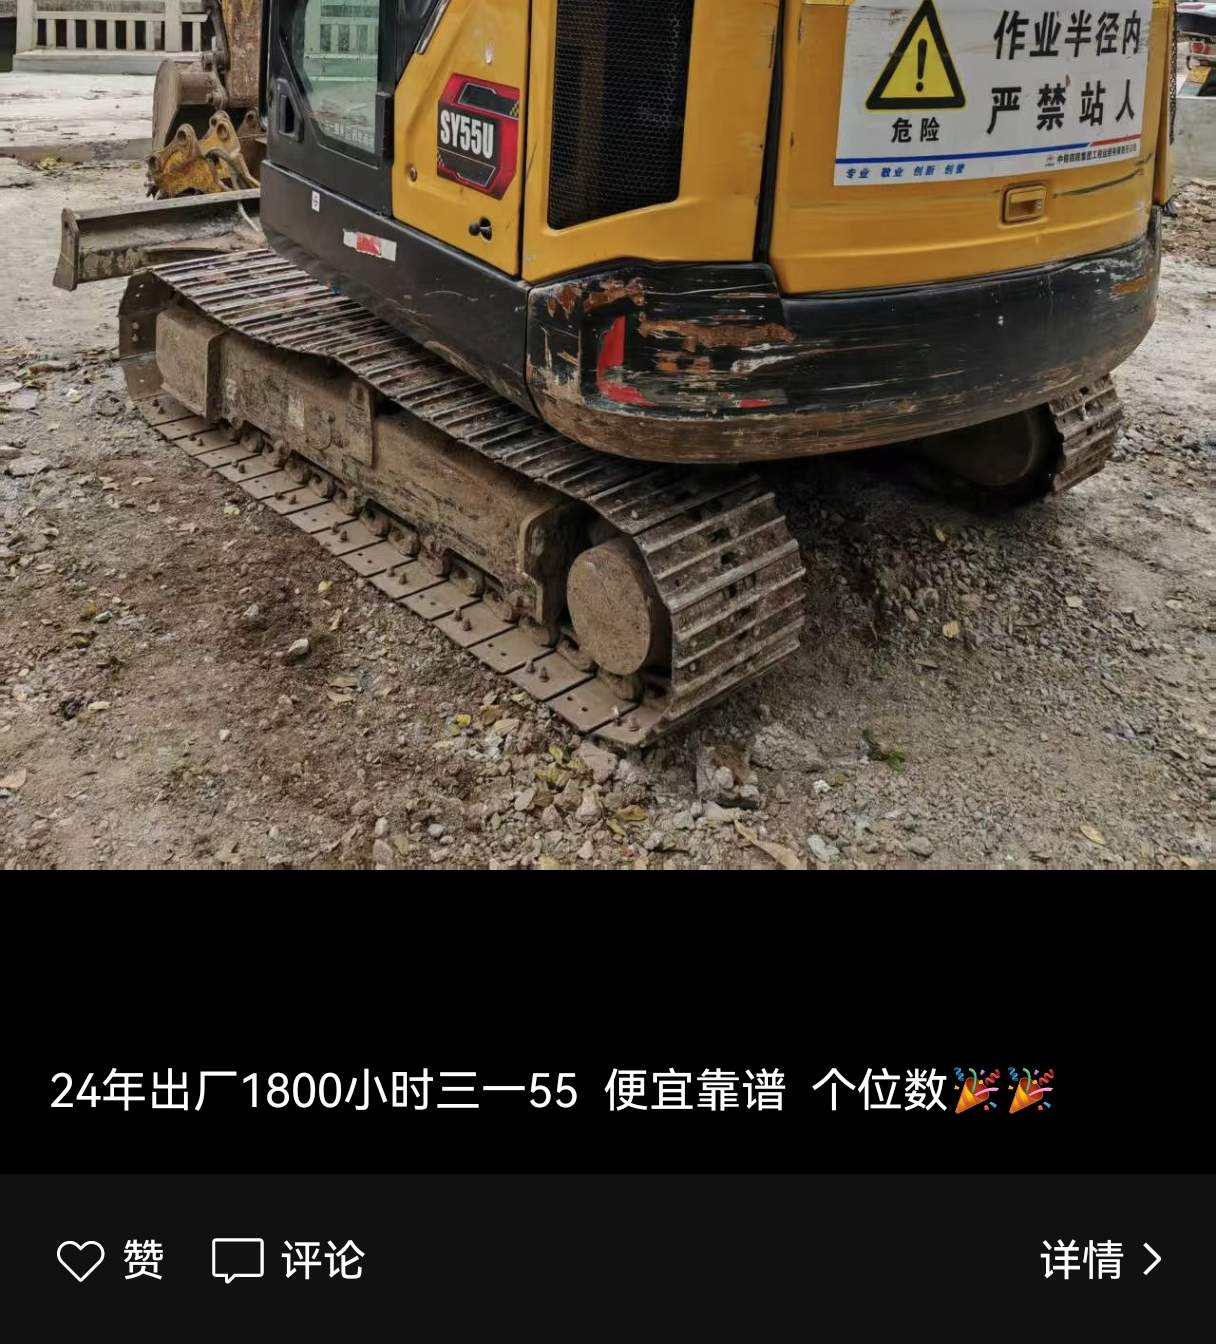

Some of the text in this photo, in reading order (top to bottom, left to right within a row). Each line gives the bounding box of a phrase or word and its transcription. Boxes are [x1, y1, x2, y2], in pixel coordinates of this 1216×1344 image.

[993, 9, 1141, 60] 作业半径内
[891, 116, 940, 143] 危险
[986, 79, 1135, 135] 严禁站人
[440, 109, 495, 160] SY55U
[846, 168, 870, 179] 专业
